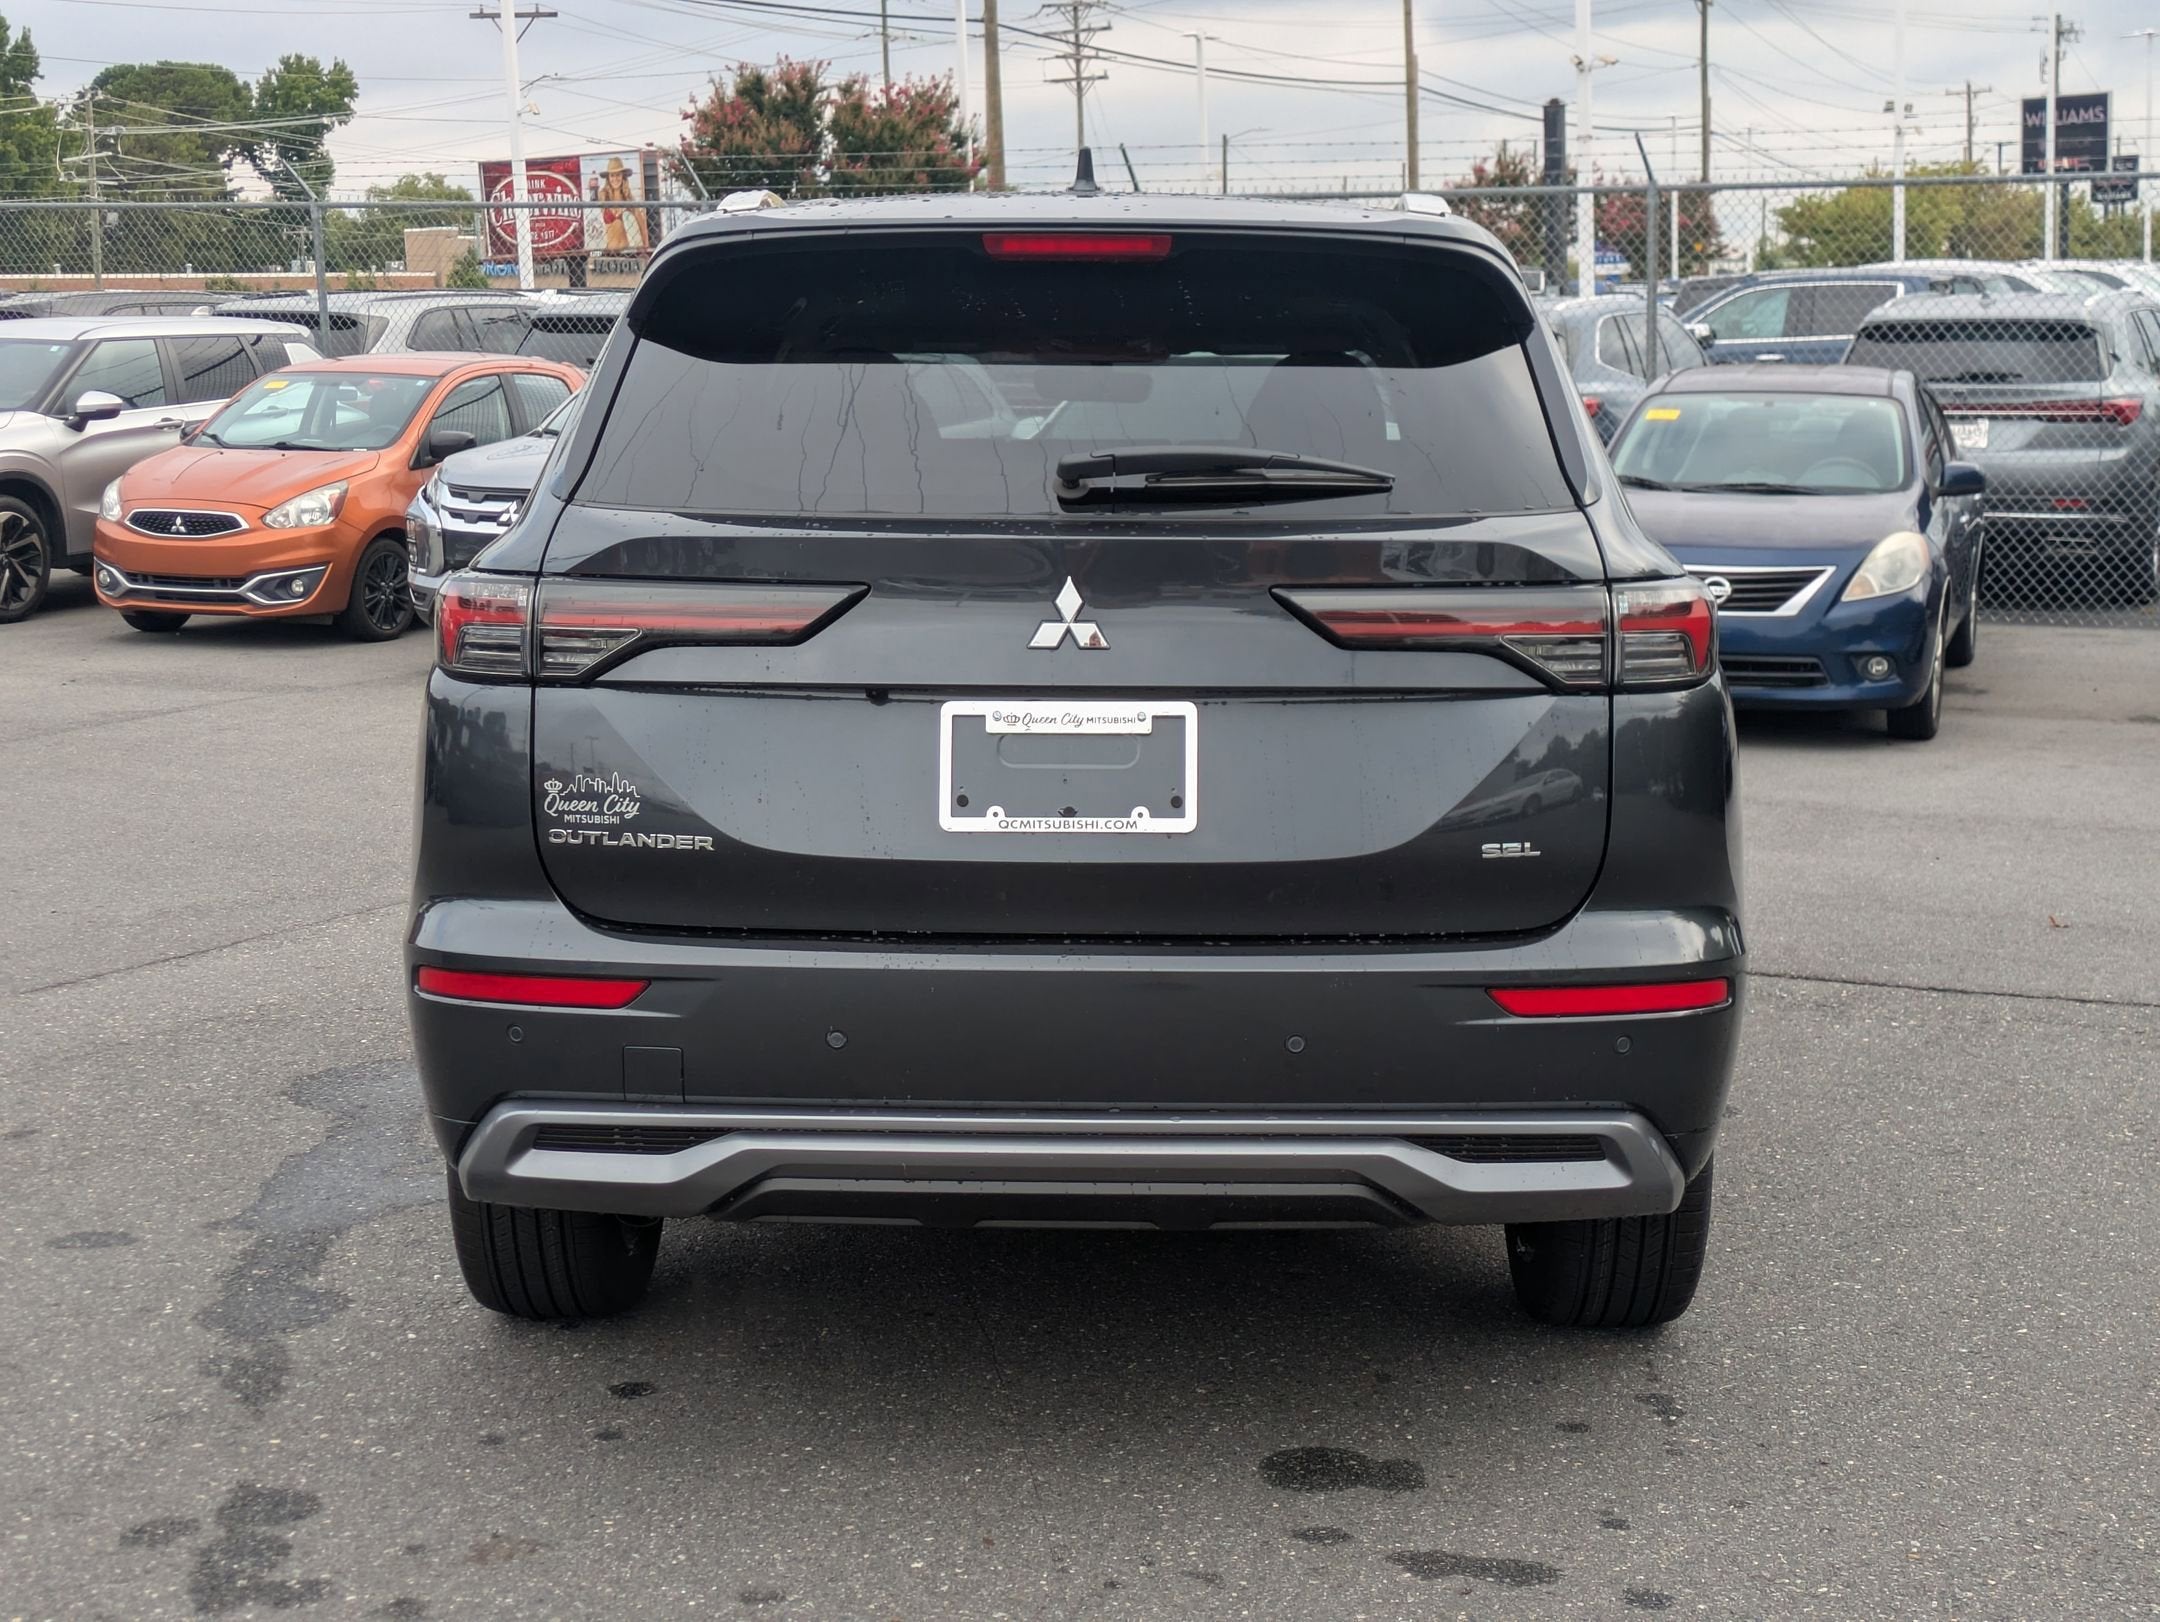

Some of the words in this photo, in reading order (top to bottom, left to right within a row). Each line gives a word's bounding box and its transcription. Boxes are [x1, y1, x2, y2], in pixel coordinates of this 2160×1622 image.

[2025, 105, 2105, 127] WILIAMS
[527, 178, 546, 190] RINK
[488, 186, 582, 226] Chrwine
[1022, 712, 1057, 728] Queen
[1061, 712, 1084, 728] City
[1086, 716, 1136, 725] MITSUBISHI
[543, 792, 599, 817] Queen
[603, 794, 641, 819] City
[564, 814, 620, 824] MITSUBISHI
[998, 819, 1138, 830] QCMITSUBISHI.COM
[547, 828, 716, 852] OUTLANDER
[1481, 841, 1542, 859] SEL
